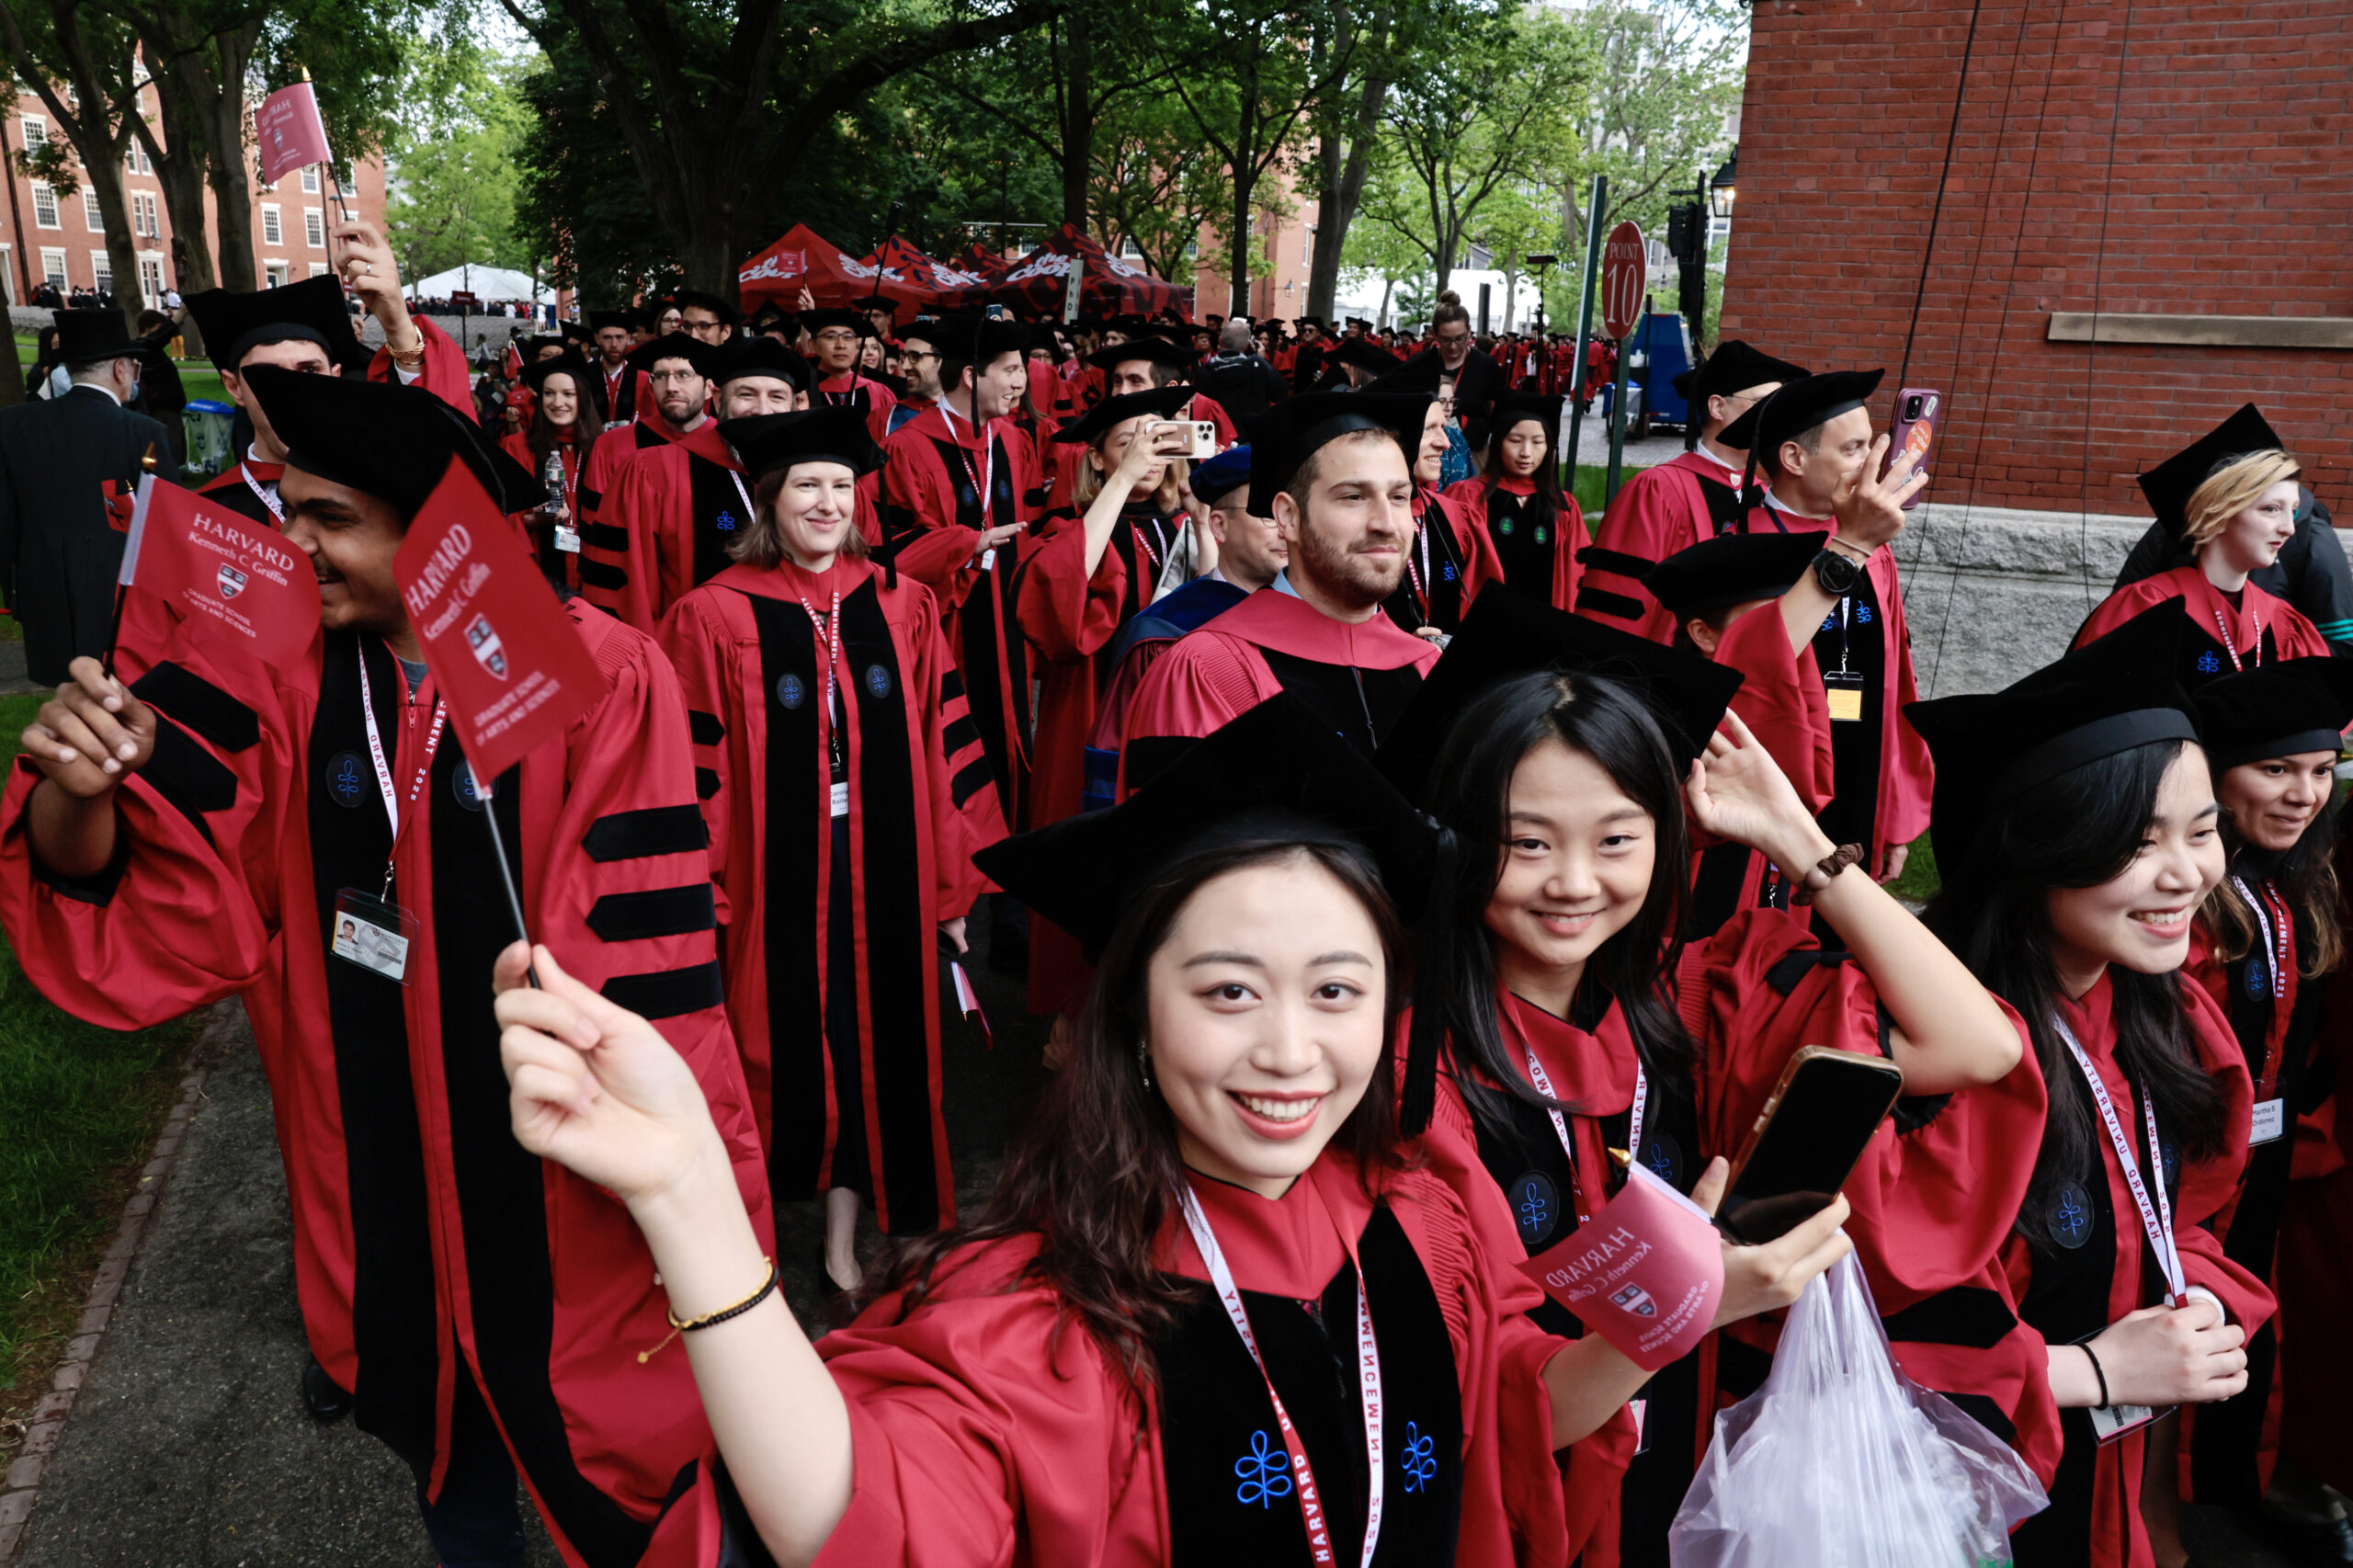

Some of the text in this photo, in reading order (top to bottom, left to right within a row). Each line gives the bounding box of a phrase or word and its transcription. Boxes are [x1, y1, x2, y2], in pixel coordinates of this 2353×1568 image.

[1609, 242, 1640, 260] POINT
[1064, 277, 1075, 312] PhD
[1607, 264, 1637, 326] 10
[188, 531, 288, 587] Kenneth C Griffin
[193, 512, 294, 572] HARVARD
[406, 523, 472, 618] HARVARD
[188, 588, 251, 627] GRADUATE SCHOOL
[208, 606, 223, 619] AND
[224, 614, 256, 639] SCIENCES
[801, 597, 828, 643] NIVERSITY
[831, 592, 839, 665] COMMENCEMENT
[1293, 1454, 1330, 1562] HARVARD
